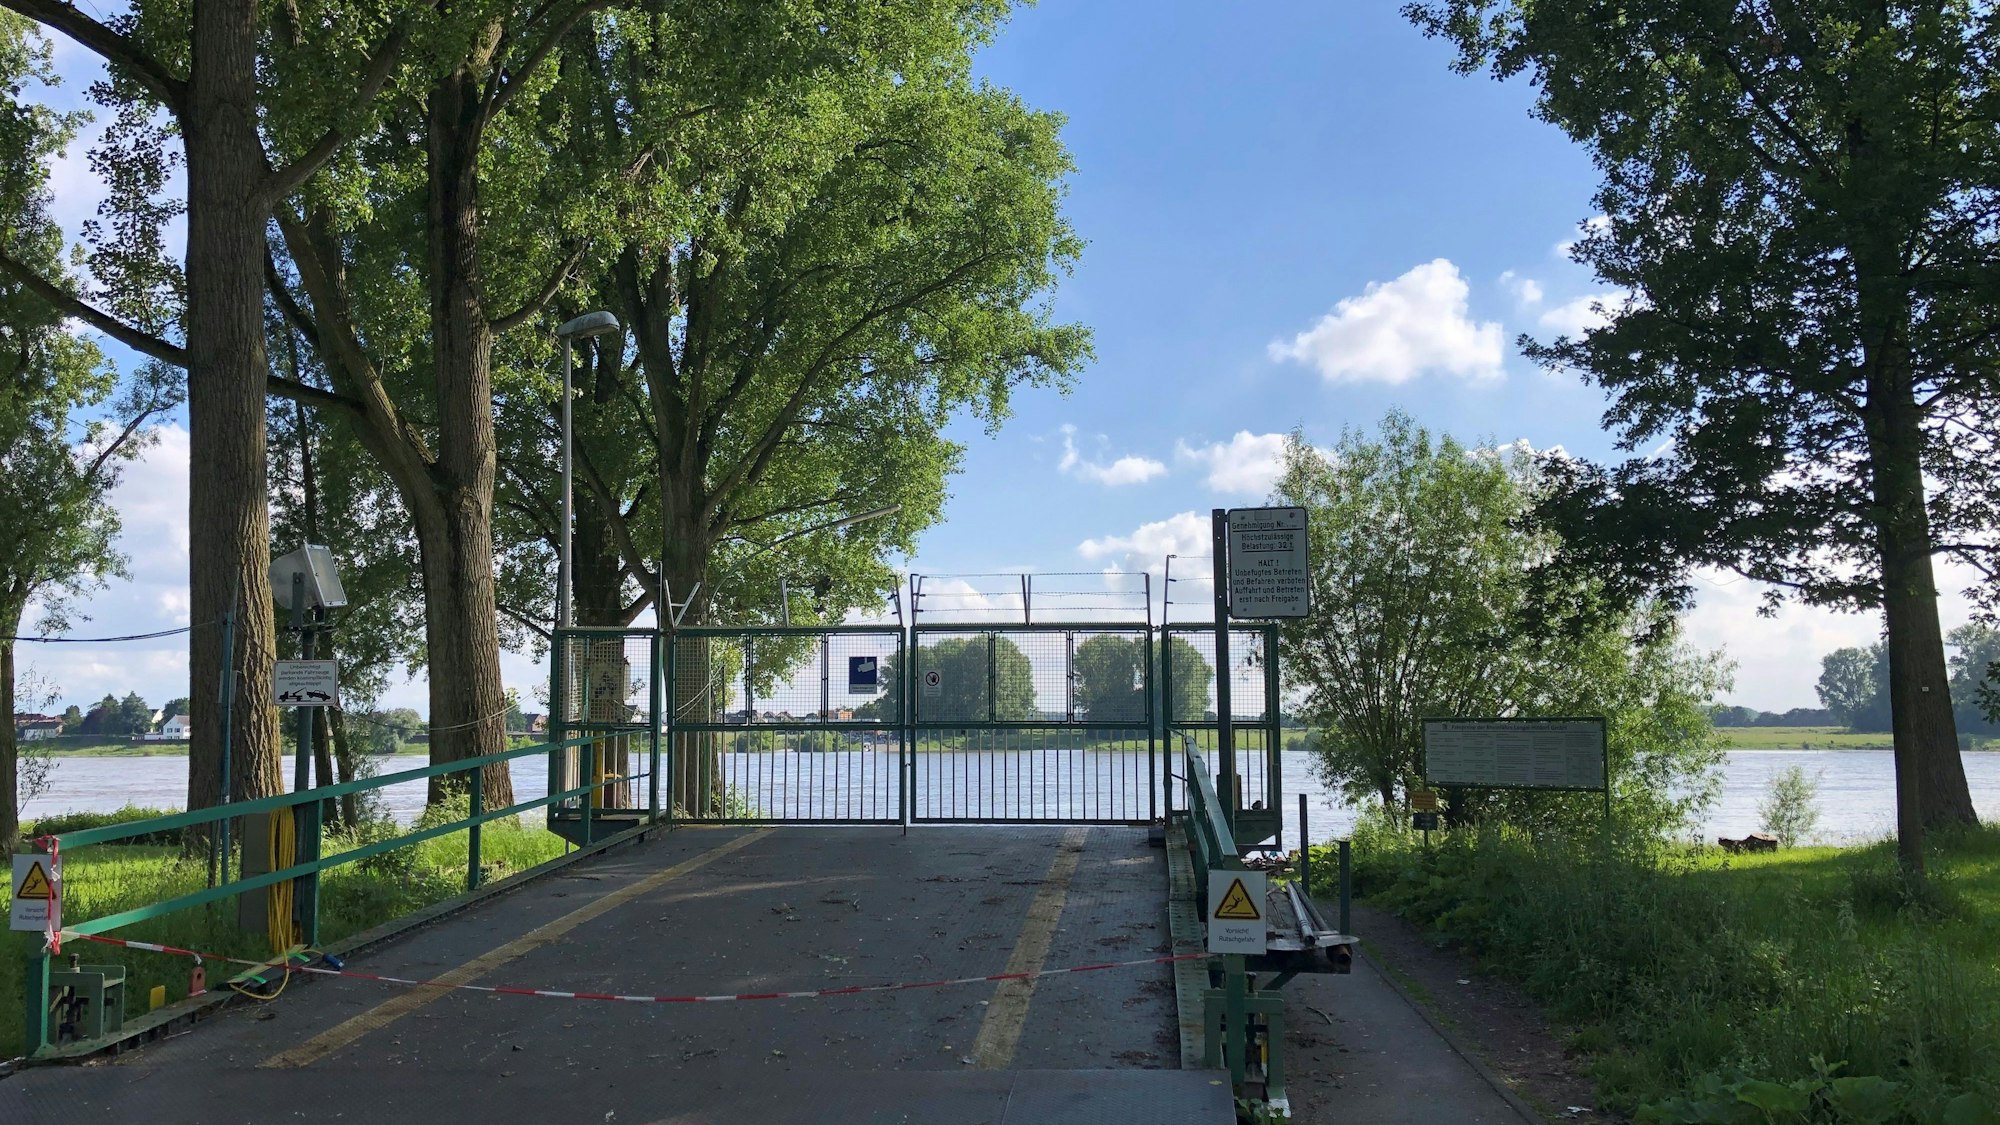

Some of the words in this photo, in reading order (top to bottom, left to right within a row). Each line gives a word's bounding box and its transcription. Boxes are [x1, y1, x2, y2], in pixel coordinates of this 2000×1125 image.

[1232, 521, 1274, 529] Genehmigung
[1241, 532, 1294, 541] Höchstzulässige
[1241, 542, 1276, 551] Belastung:
[1278, 541, 1287, 549] 32
[1258, 559, 1274, 567] HALT
[1235, 568, 1272, 577] Unbefugtes
[1273, 568, 1303, 576] Betreten
[1232, 578, 1244, 586] und
[1246, 577, 1276, 585] Befahren
[1277, 577, 1306, 585] verboten
[1235, 586, 1261, 594] Auffahrt
[1262, 586, 1274, 594] und
[1276, 585, 1305, 593] Betreten
[1239, 595, 1252, 603] erst
[1254, 595, 1270, 603] nach
